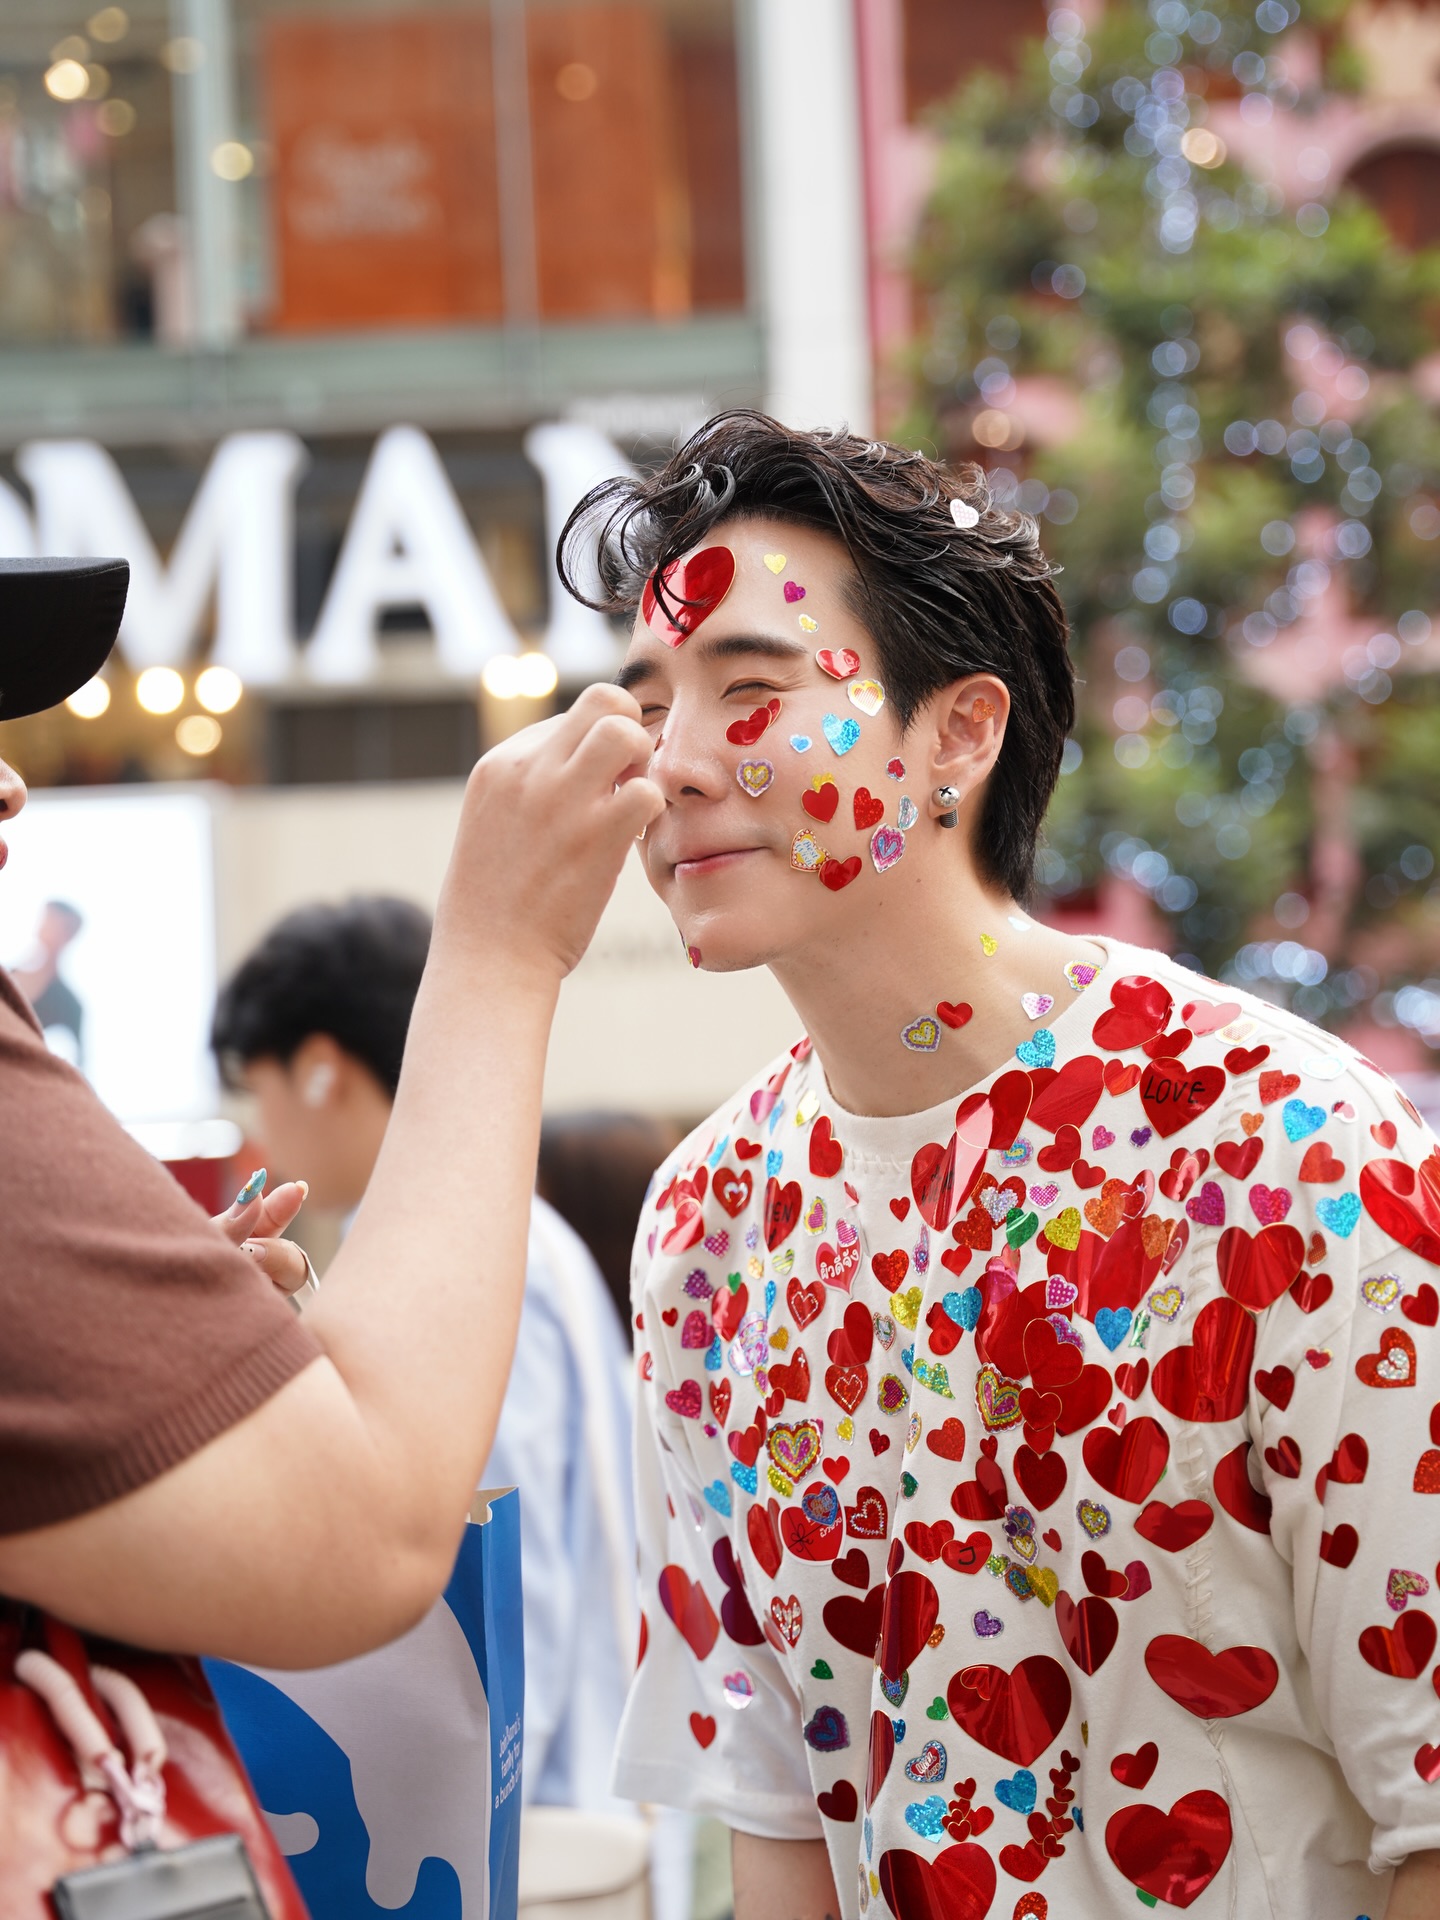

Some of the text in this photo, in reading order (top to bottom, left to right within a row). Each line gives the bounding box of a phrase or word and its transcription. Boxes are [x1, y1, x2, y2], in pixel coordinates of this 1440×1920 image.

[1143, 1075, 1206, 1105] LOVE
[820, 1248, 860, 1280] ผิวดีจัง
[915, 1751, 937, 1774] With
[925, 1762, 940, 1780] love
[494, 1794, 500, 1810] a
[500, 1771, 516, 1805] bunch
